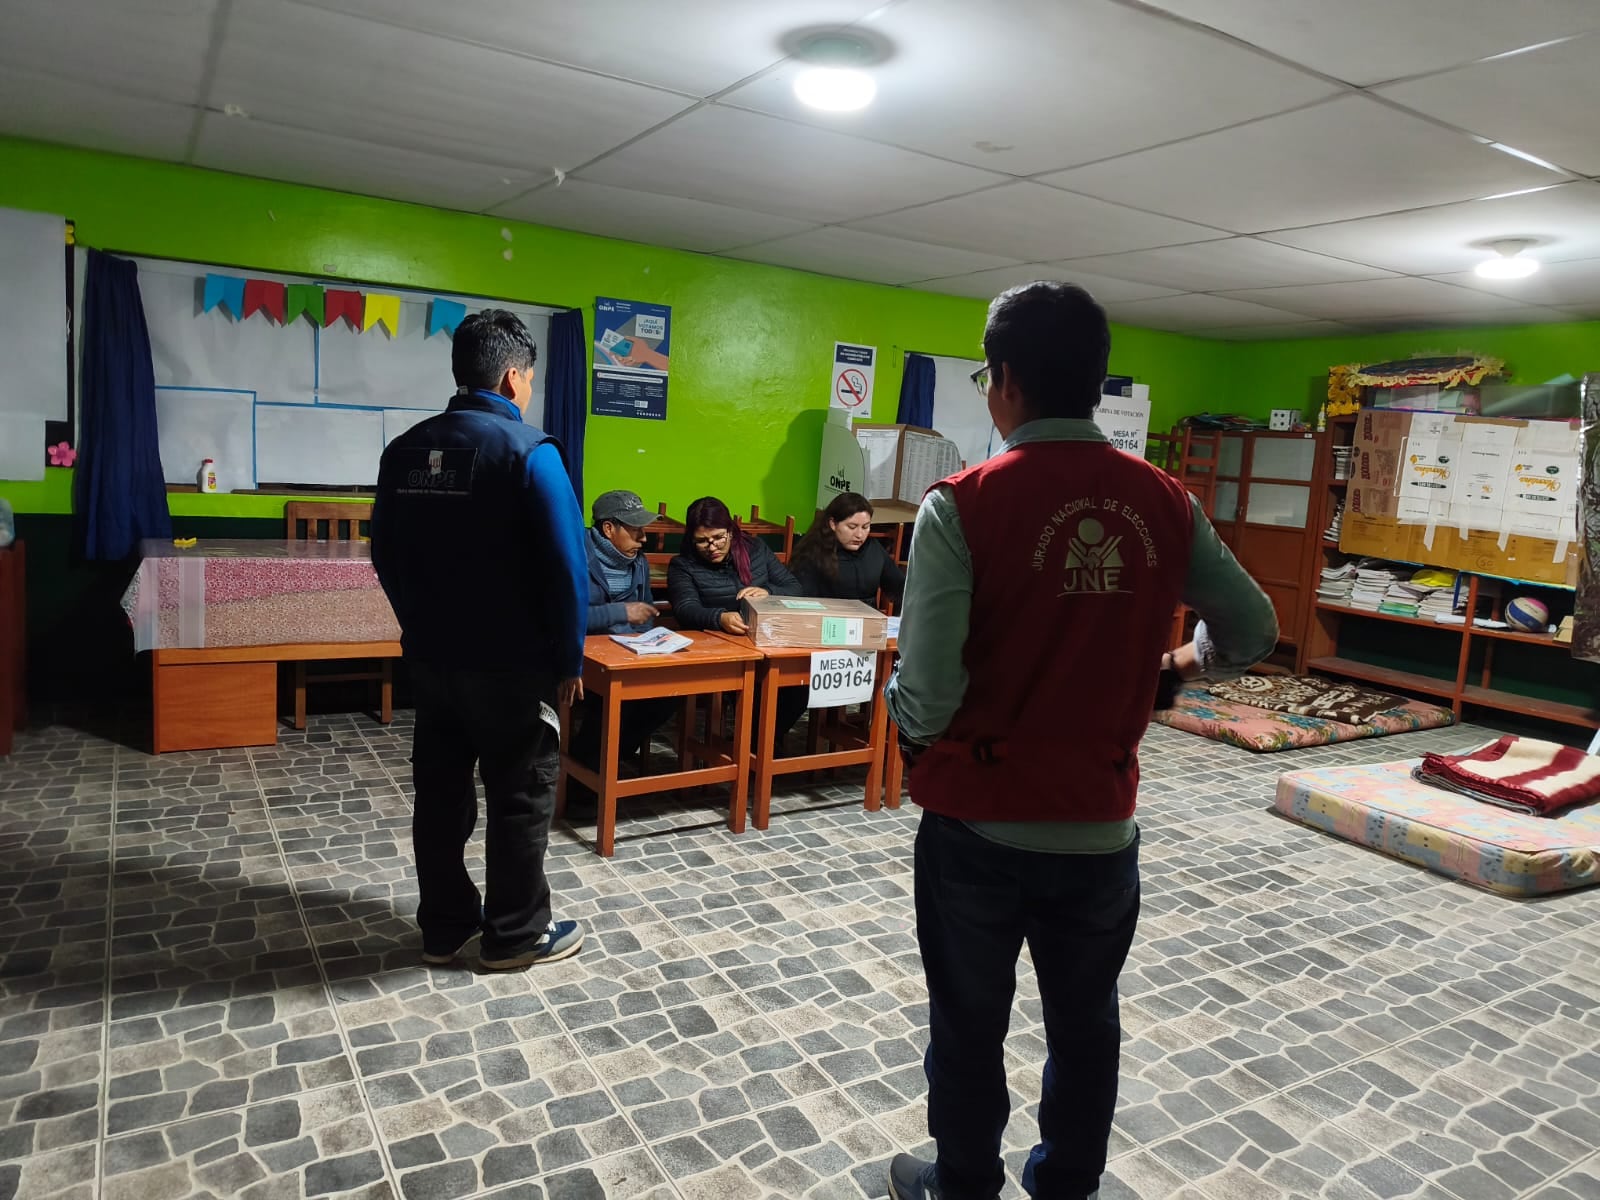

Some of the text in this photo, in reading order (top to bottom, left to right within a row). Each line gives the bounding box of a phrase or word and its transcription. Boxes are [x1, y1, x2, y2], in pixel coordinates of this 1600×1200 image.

[1113, 430, 1129, 438] MESA
[830, 475, 851, 492] ONPE
[1032, 497, 1158, 572] JURADO NACIONAL DE ELECCIONES
[1063, 568, 1121, 591] JNE
[820, 658, 853, 671] MESA
[811, 670, 872, 690] 009164
